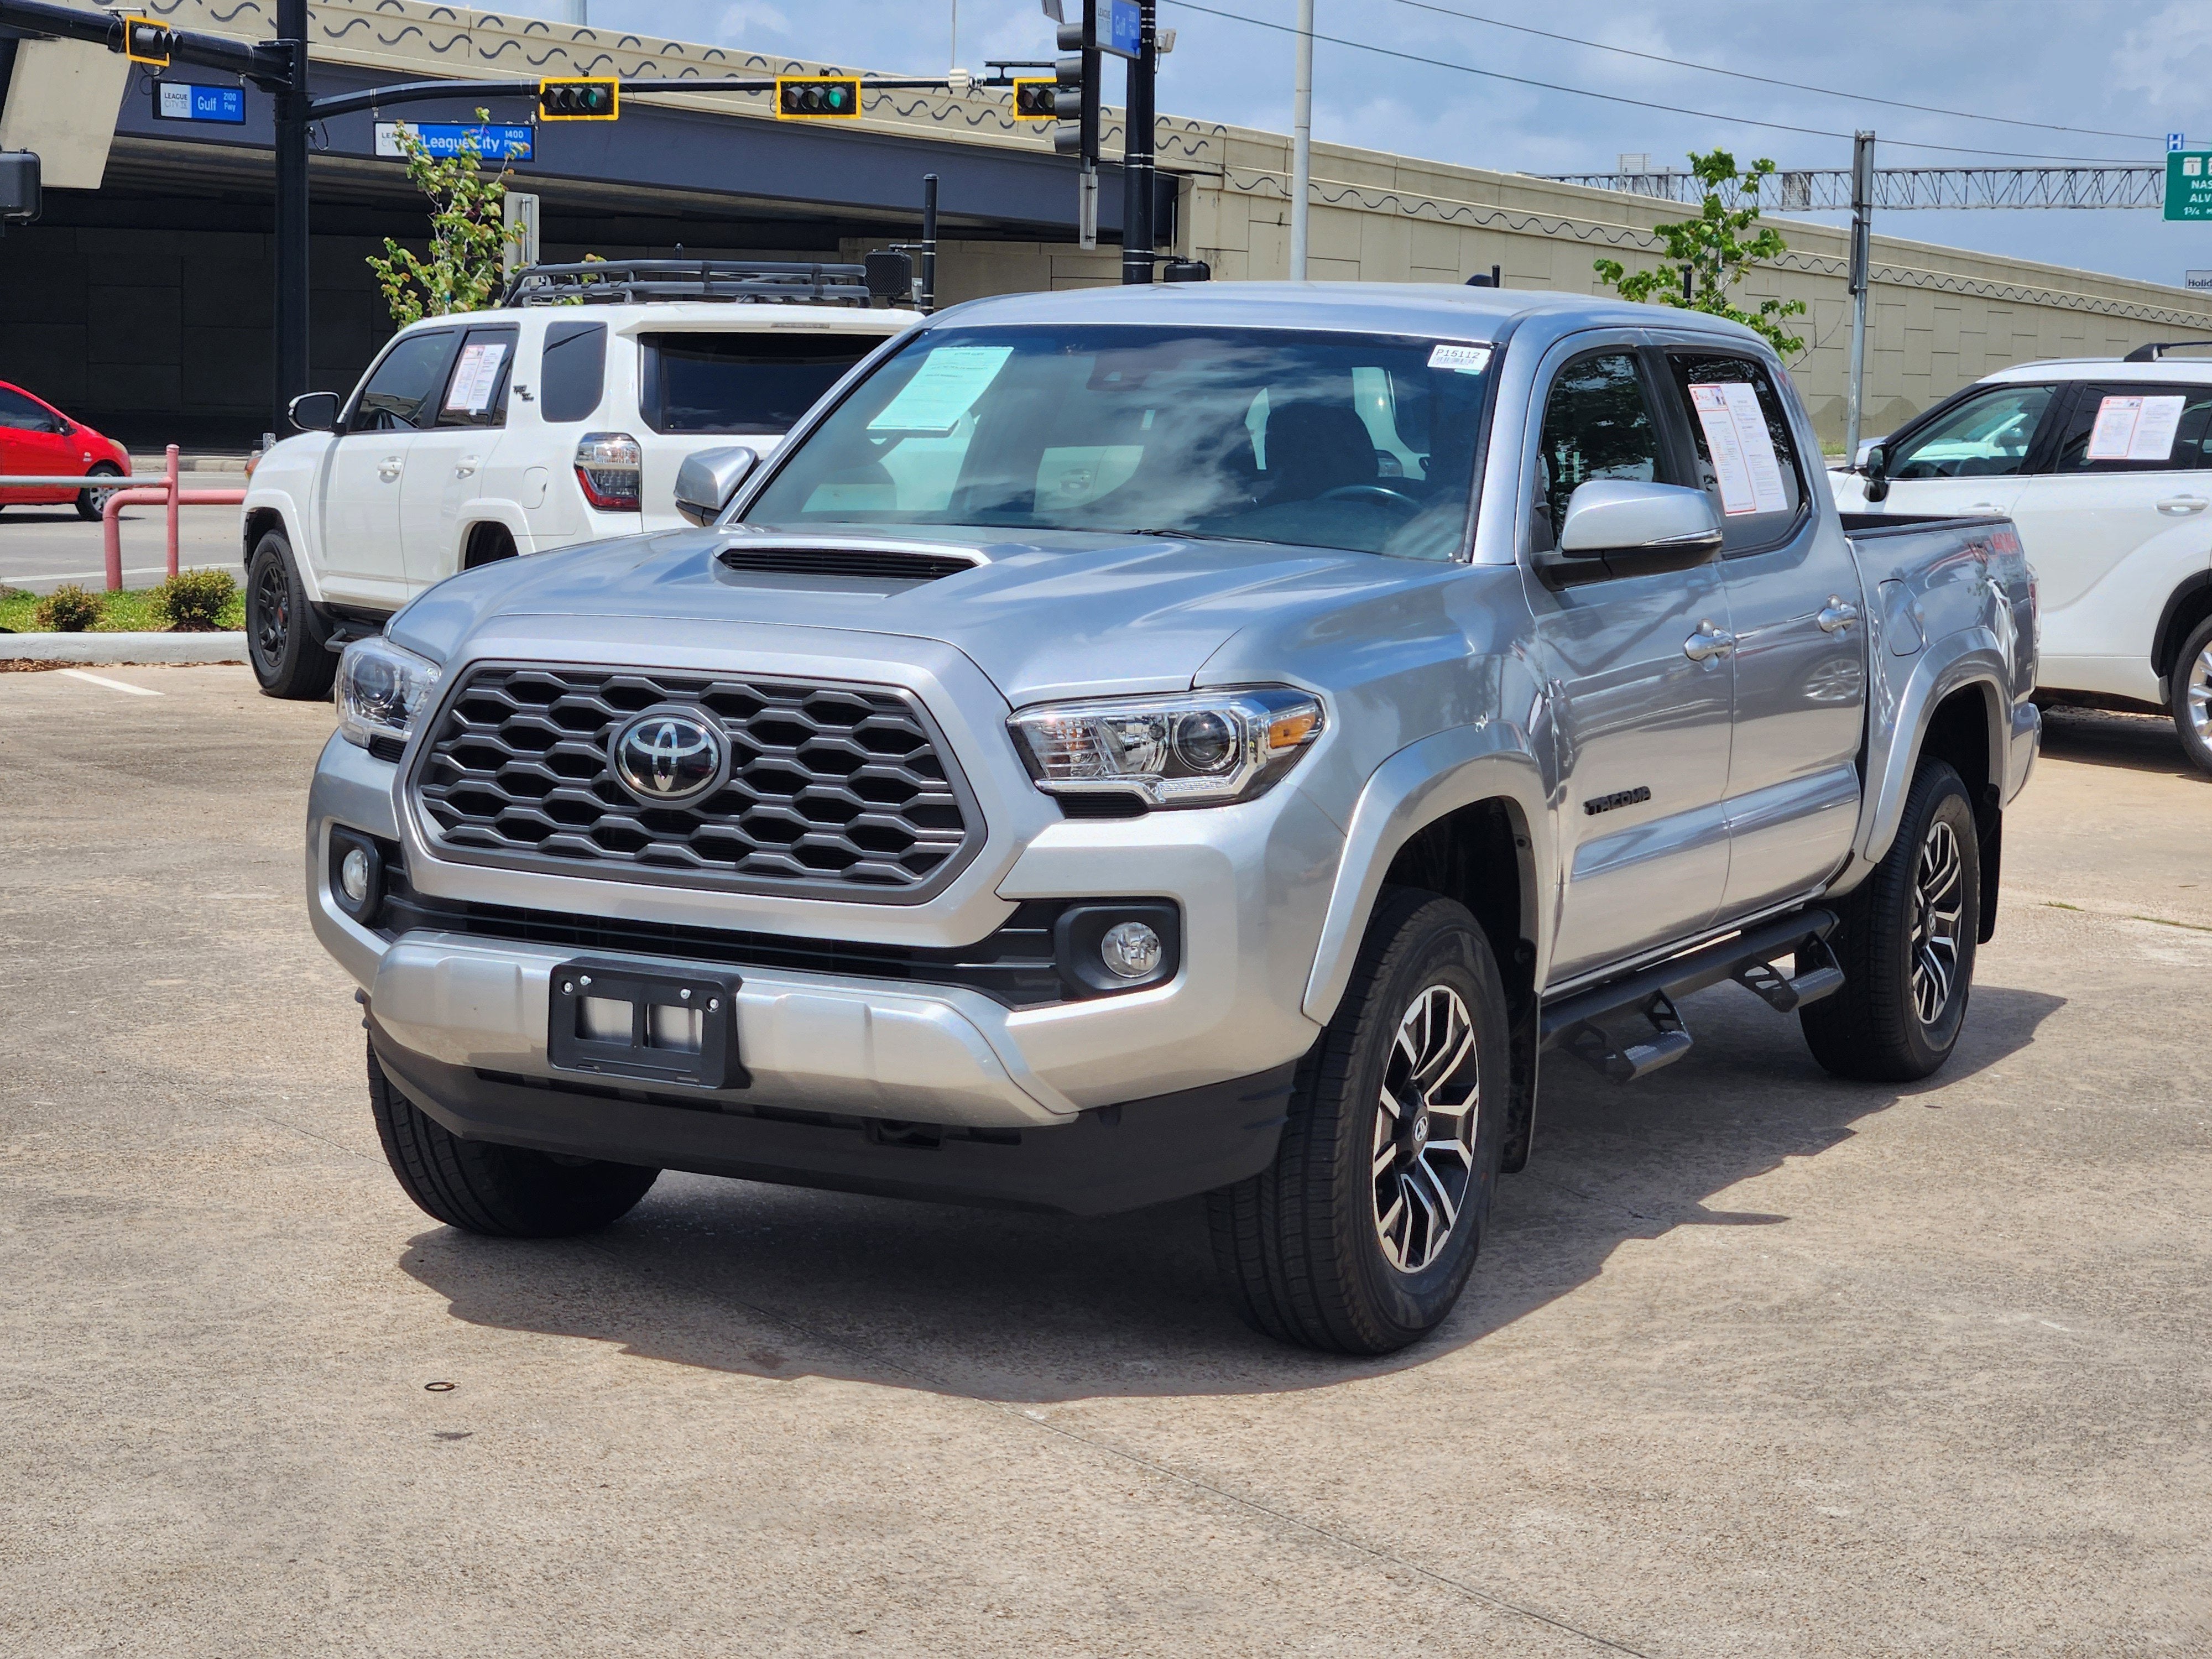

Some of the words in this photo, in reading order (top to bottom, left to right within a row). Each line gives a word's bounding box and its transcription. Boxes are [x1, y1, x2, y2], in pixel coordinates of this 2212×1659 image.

[164, 92, 188, 100] LEAGUE
[197, 96, 217, 111] Gulf
[224, 102, 236, 113] Fwy
[504, 130, 524, 139] 1400
[422, 134, 470, 153] League
[1436, 349, 1480, 359] P15112
